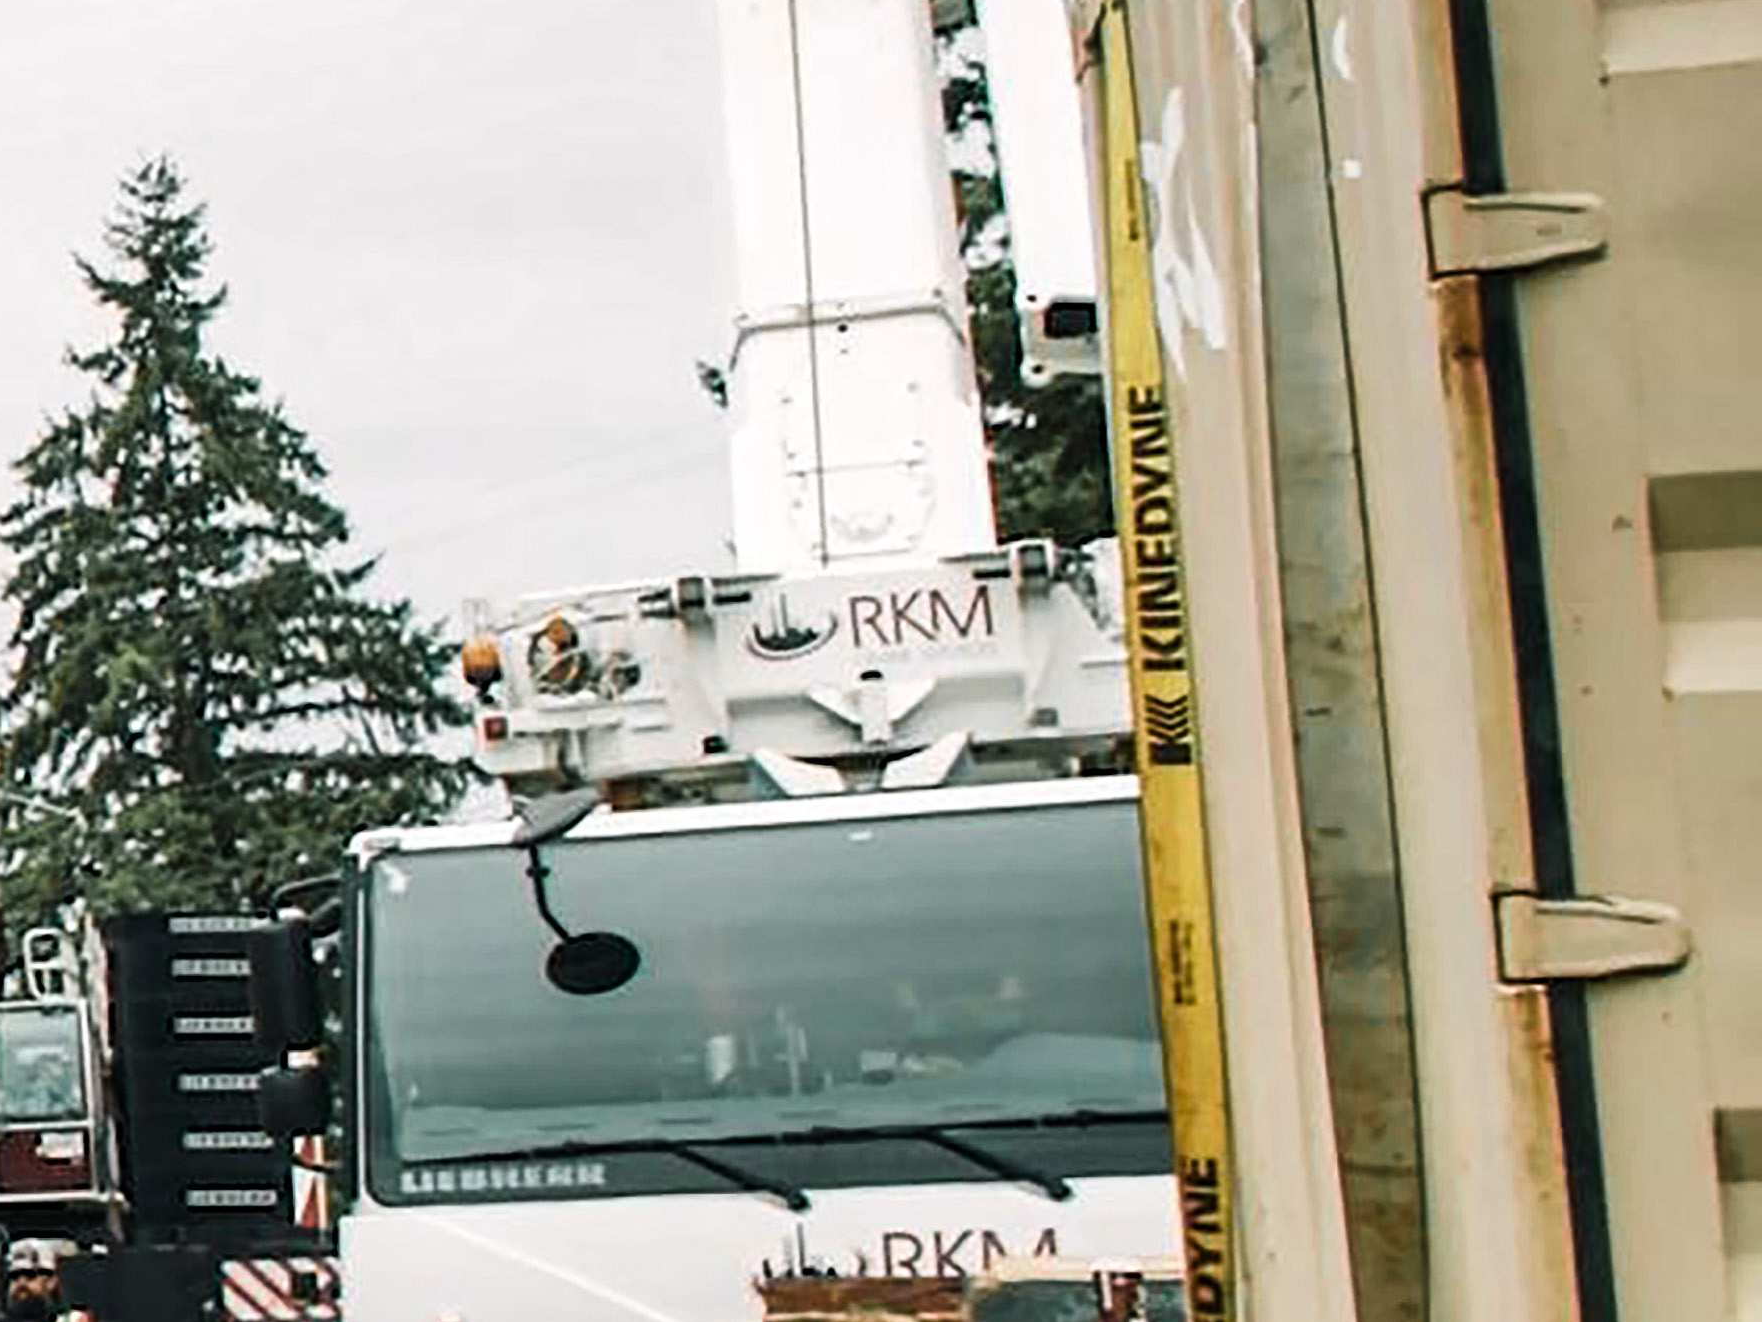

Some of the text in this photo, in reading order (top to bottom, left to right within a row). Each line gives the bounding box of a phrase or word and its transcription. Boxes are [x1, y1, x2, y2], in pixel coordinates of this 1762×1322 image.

[1128, 385, 1186, 673] KINEDYNE
[848, 584, 994, 648] RKM
[400, 1162, 606, 1195] LIEBHERR
